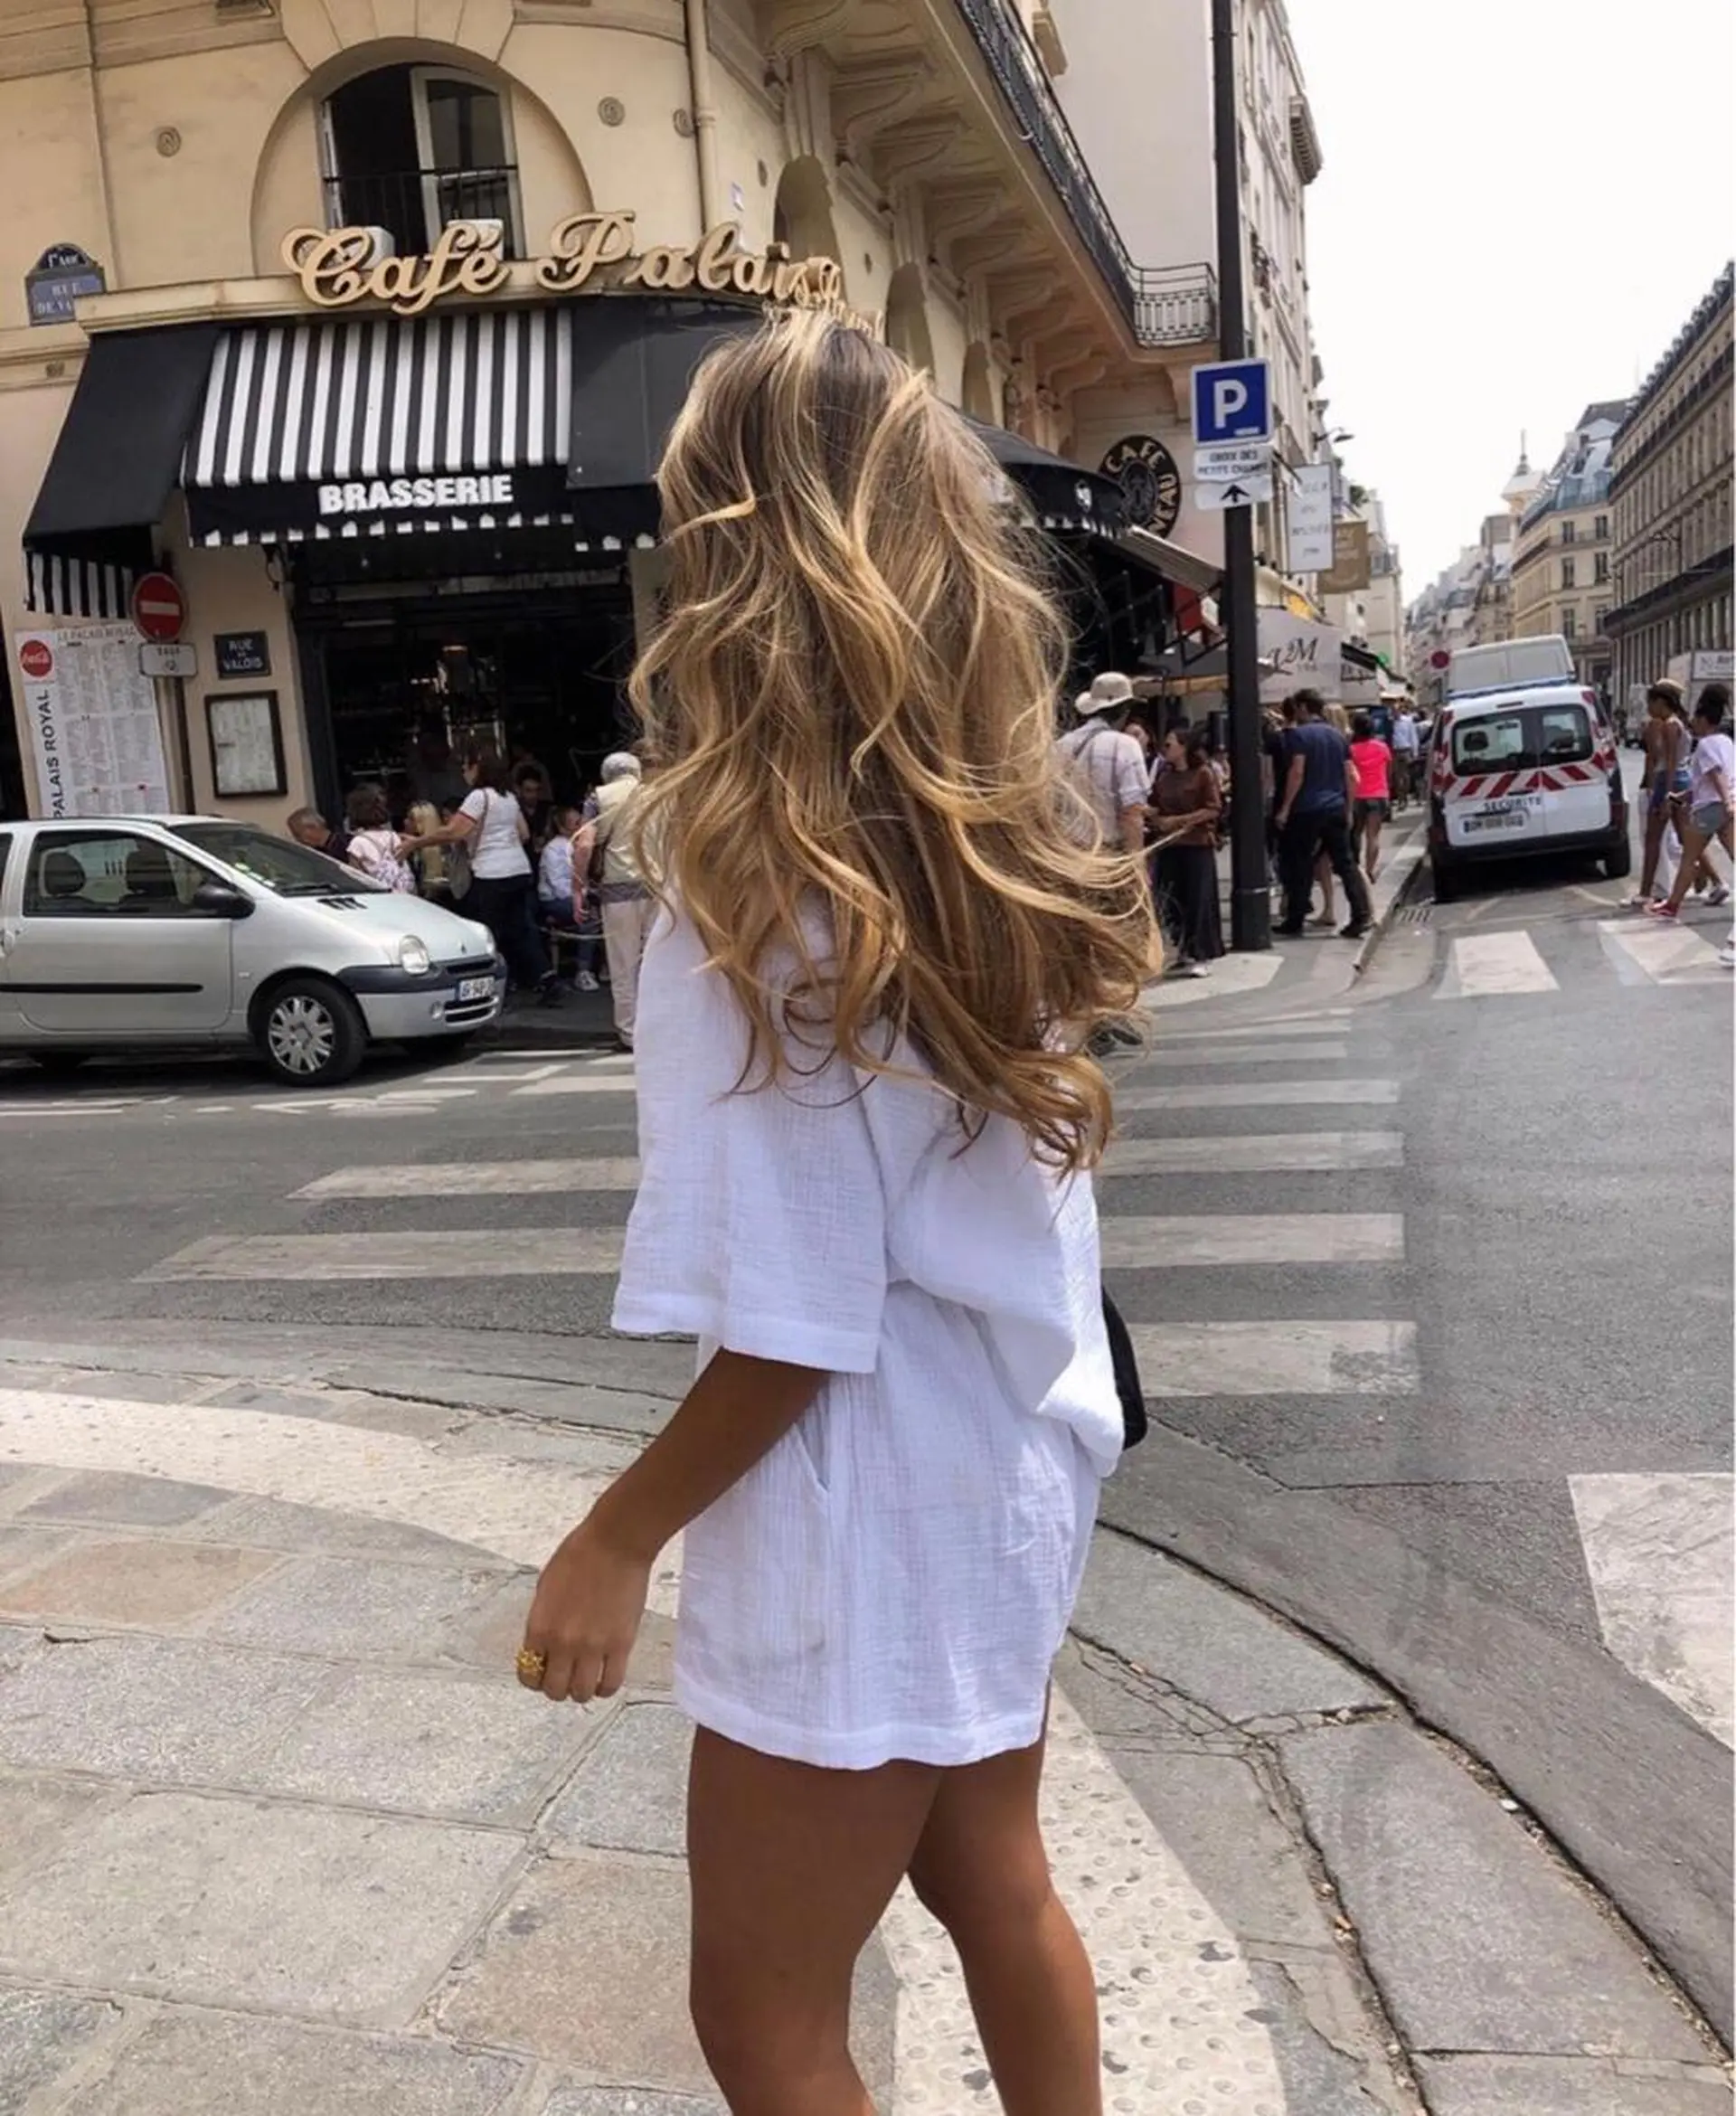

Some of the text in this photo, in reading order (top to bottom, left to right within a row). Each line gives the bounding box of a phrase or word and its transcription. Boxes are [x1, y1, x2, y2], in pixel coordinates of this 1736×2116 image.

[281, 225, 512, 314] Café
[1214, 379, 1248, 429] P
[318, 475, 514, 515] BRASSERIE
[229, 638, 253, 651] RUE
[36, 690, 57, 751] ROYAL
